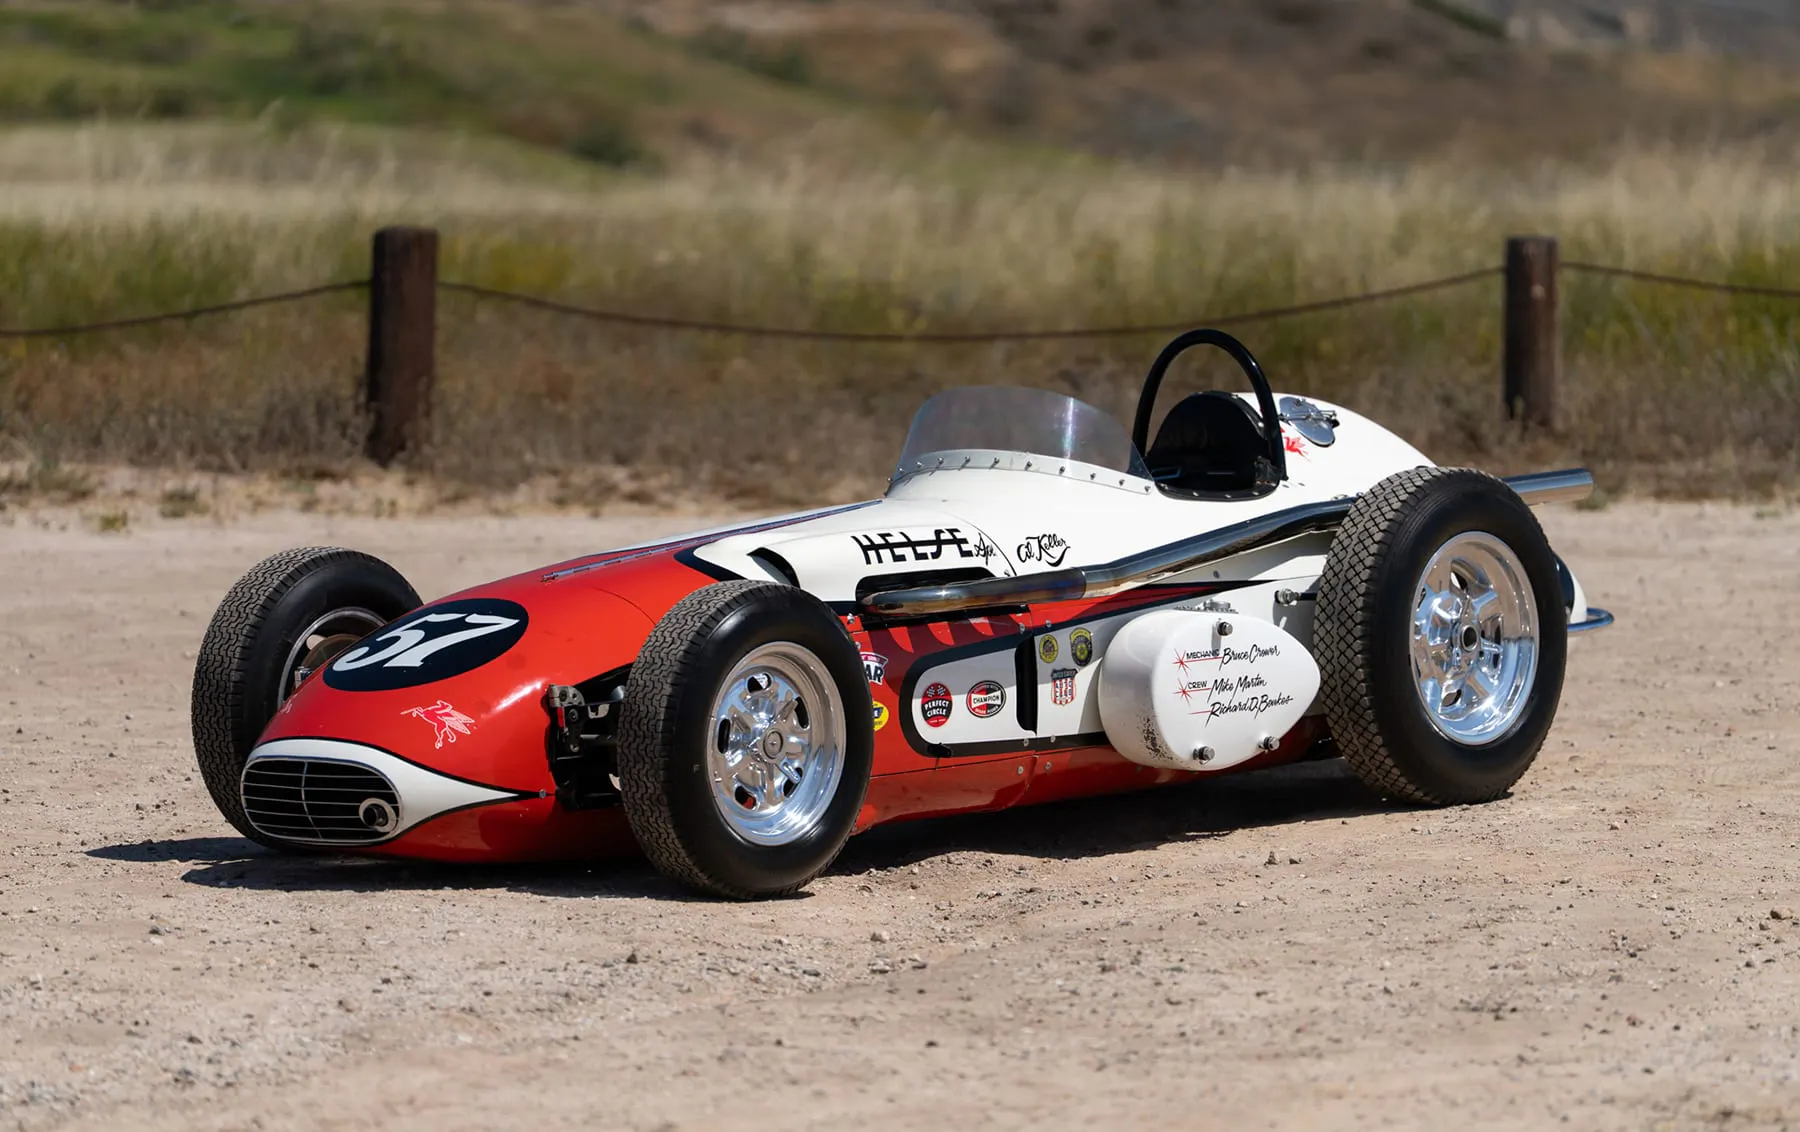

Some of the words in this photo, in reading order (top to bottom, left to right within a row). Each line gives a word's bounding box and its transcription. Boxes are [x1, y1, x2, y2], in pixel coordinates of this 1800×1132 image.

[850, 528, 974, 565] HELSE
[1017, 542, 1034, 563] Al
[1025, 533, 1071, 567] Keller
[332, 613, 520, 671] 57
[1186, 649, 1220, 659] MECHANIC
[1219, 647, 1249, 671] Bruce
[1249, 643, 1281, 664] Crower
[864, 663, 884, 683] AR
[1187, 681, 1208, 690] CREW
[1206, 677, 1234, 704] Mike
[1228, 673, 1268, 707] Martin
[924, 700, 950, 711] PERFECT
[972, 694, 1000, 705] CHAMPION
[926, 708, 947, 718] CIRCLE
[1204, 697, 1250, 729] Richard
